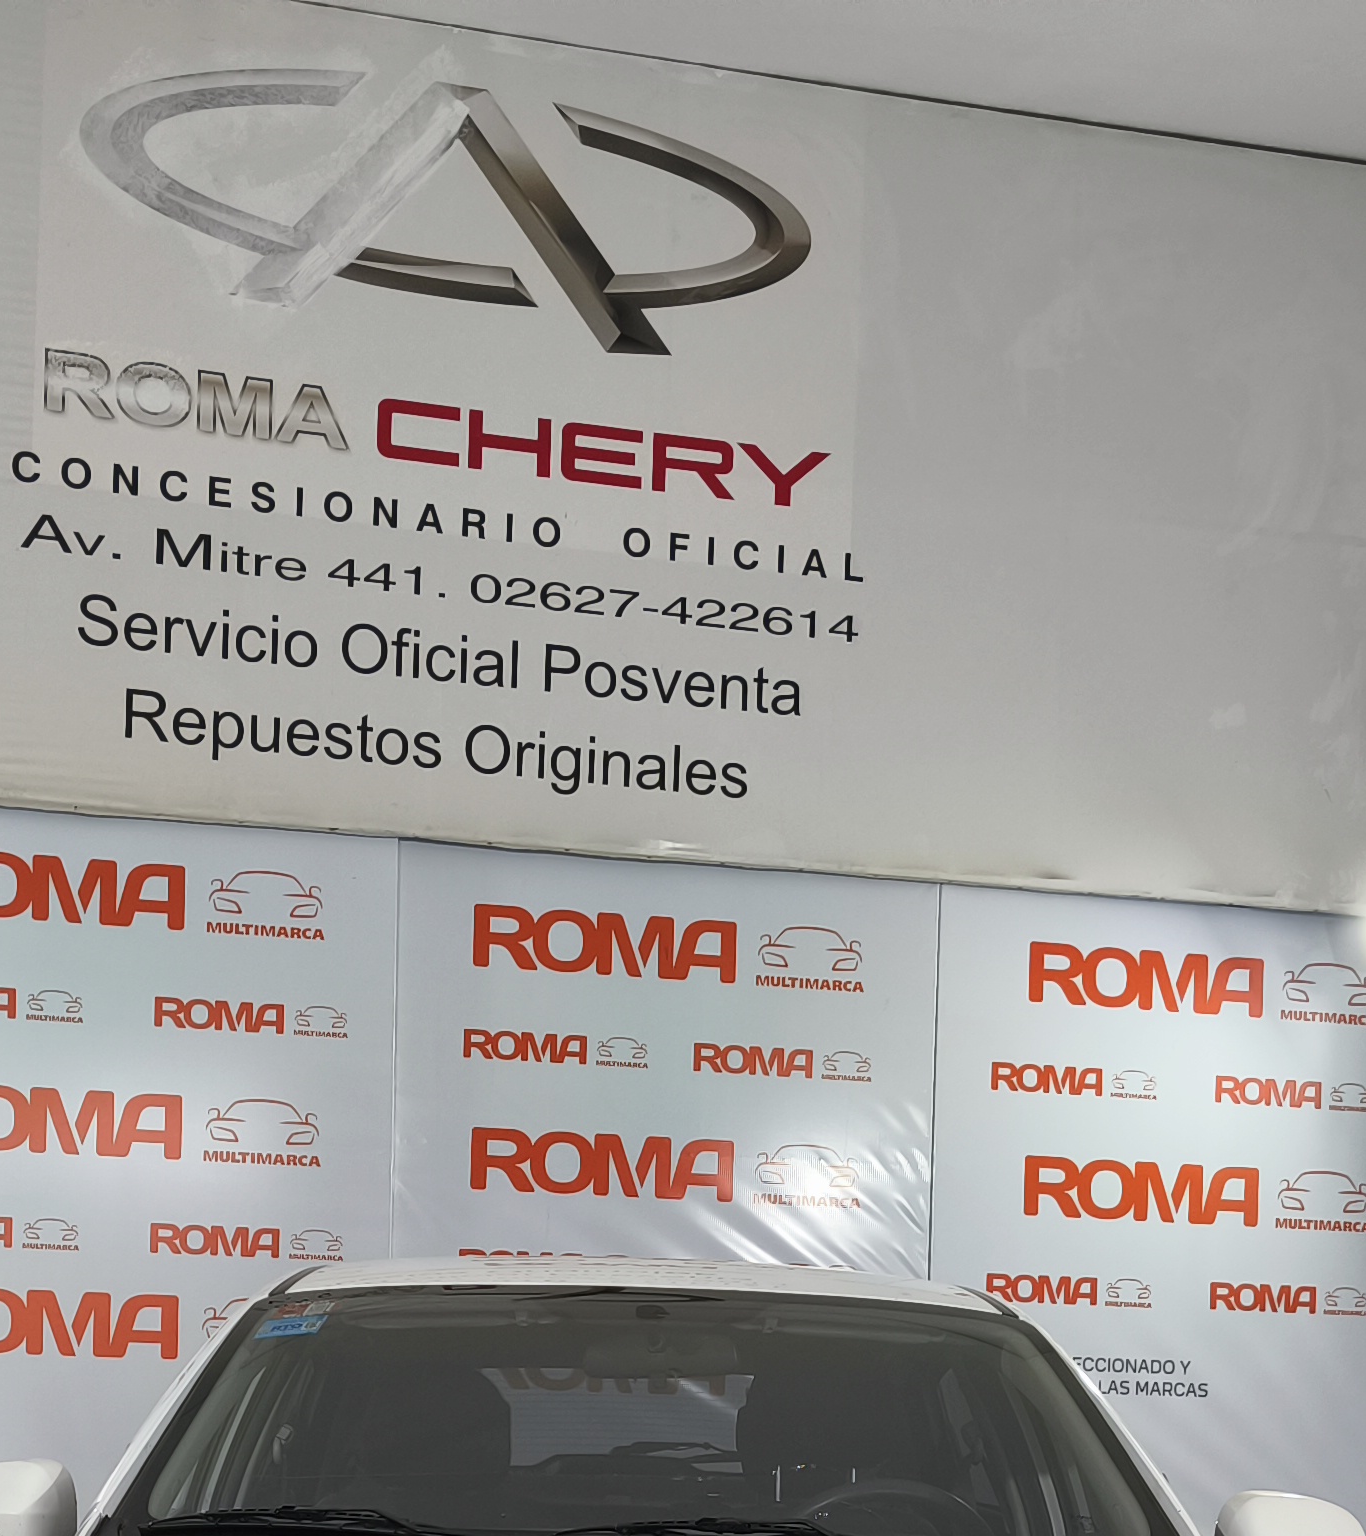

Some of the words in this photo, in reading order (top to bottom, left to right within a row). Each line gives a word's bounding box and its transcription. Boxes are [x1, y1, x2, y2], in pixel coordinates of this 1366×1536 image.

[43, 347, 351, 451] ROMA
[376, 398, 831, 507] CHERY
[11, 449, 562, 549] CONCESIONARIO
[623, 526, 864, 583] OFICIAL
[20, 513, 122, 560] Av.
[154, 527, 308, 582] Mitre
[327, 559, 447, 599] 441.
[470, 572, 862, 643] 02627-422614
[77, 593, 318, 669] Servicio
[341, 622, 520, 689] Oficial
[544, 642, 803, 717] Posventa
[124, 688, 443, 769] Repuestos
[465, 723, 749, 799] Originales
[206, 921, 325, 941] MULTIMARCA
[472, 903, 738, 985] ROMA
[755, 974, 864, 993] MULTIMARCA
[1028, 941, 1265, 1019] ROMA
[154, 996, 285, 1036] ROMA
[462, 1028, 588, 1066] ROMA
[692, 1042, 814, 1080] ROMA
[990, 1061, 1104, 1098] ROMA
[1214, 1075, 1323, 1110] ROMA
[203, 1150, 321, 1167] MULTIMARCA
[469, 1126, 736, 1204] ROMA
[753, 1193, 861, 1209] MULTIMARCA
[1023, 1155, 1260, 1228] ROMA
[150, 1223, 281, 1260] ROMA
[986, 1273, 1099, 1307] ROMA
[1209, 1281, 1318, 1315] ROMA
[1179, 1360, 1191, 1375] Y
[1098, 1380, 1130, 1396] LAS
[1135, 1381, 1208, 1398] MARCAS
